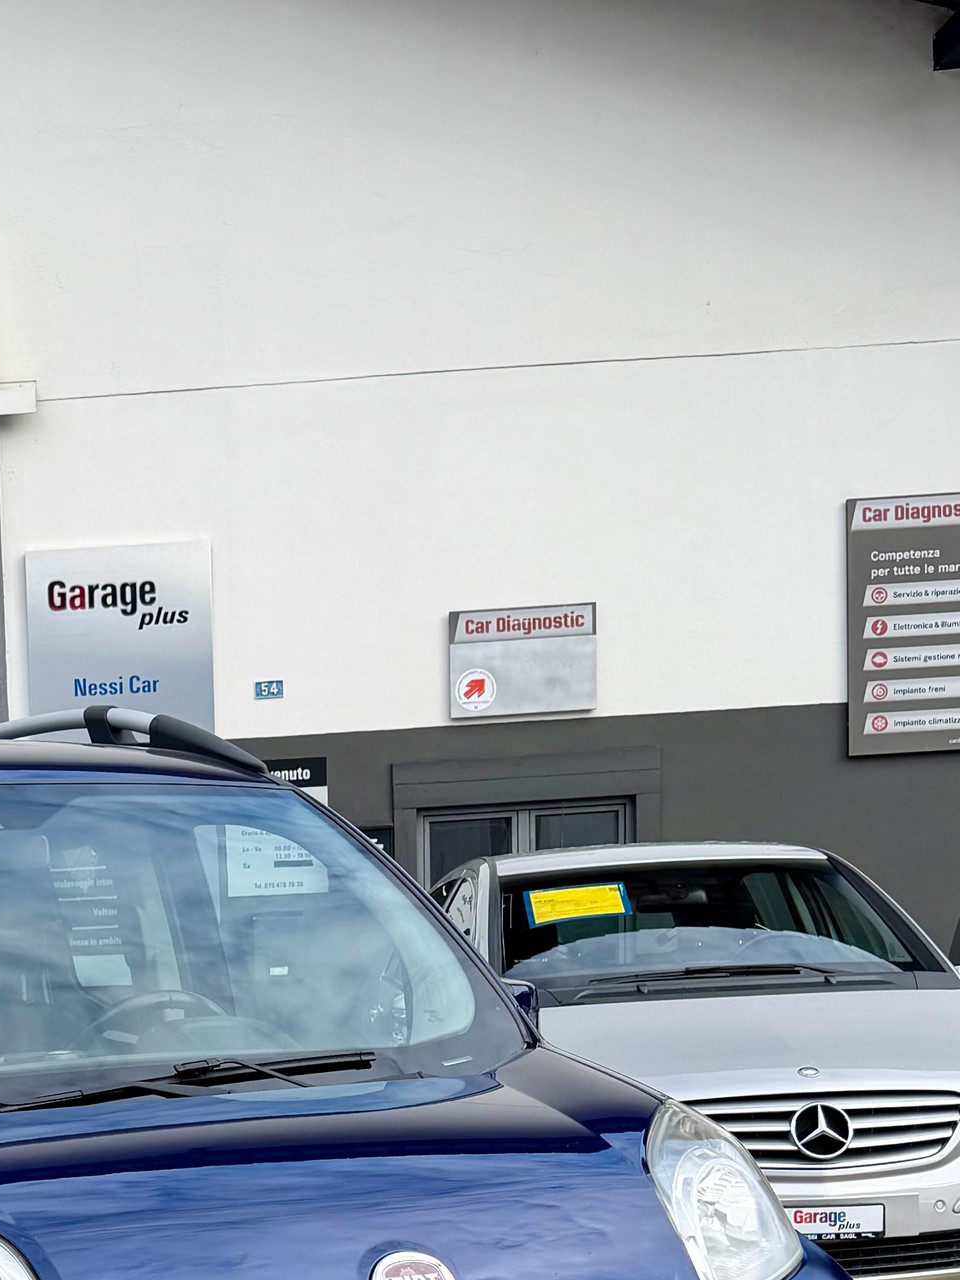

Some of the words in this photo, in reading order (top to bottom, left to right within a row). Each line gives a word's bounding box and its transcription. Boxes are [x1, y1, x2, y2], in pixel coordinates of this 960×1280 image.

[862, 506, 890, 523] Car
[870, 548, 940, 563] Competenza
[871, 568, 890, 580] per
[893, 565, 921, 576] tutte
[924, 563, 934, 574] le
[938, 563, 960, 574] mar
[47, 580, 157, 616] Garage
[893, 590, 923, 599] Servizio
[138, 607, 190, 630] plus
[465, 619, 492, 634] Car
[496, 611, 585, 635] Diagnostic
[893, 622, 933, 631] Elettronica
[893, 655, 921, 663] Sistemi
[923, 653, 956, 663] gestione
[74, 677, 123, 697] Nessi
[129, 675, 160, 693] Car
[261, 683, 279, 695] 54
[893, 686, 927, 696] Impianto
[928, 685, 946, 694] freni
[893, 719, 927, 728] Impianto
[793, 1209, 846, 1227] Garage
[837, 1221, 861, 1231] plus
